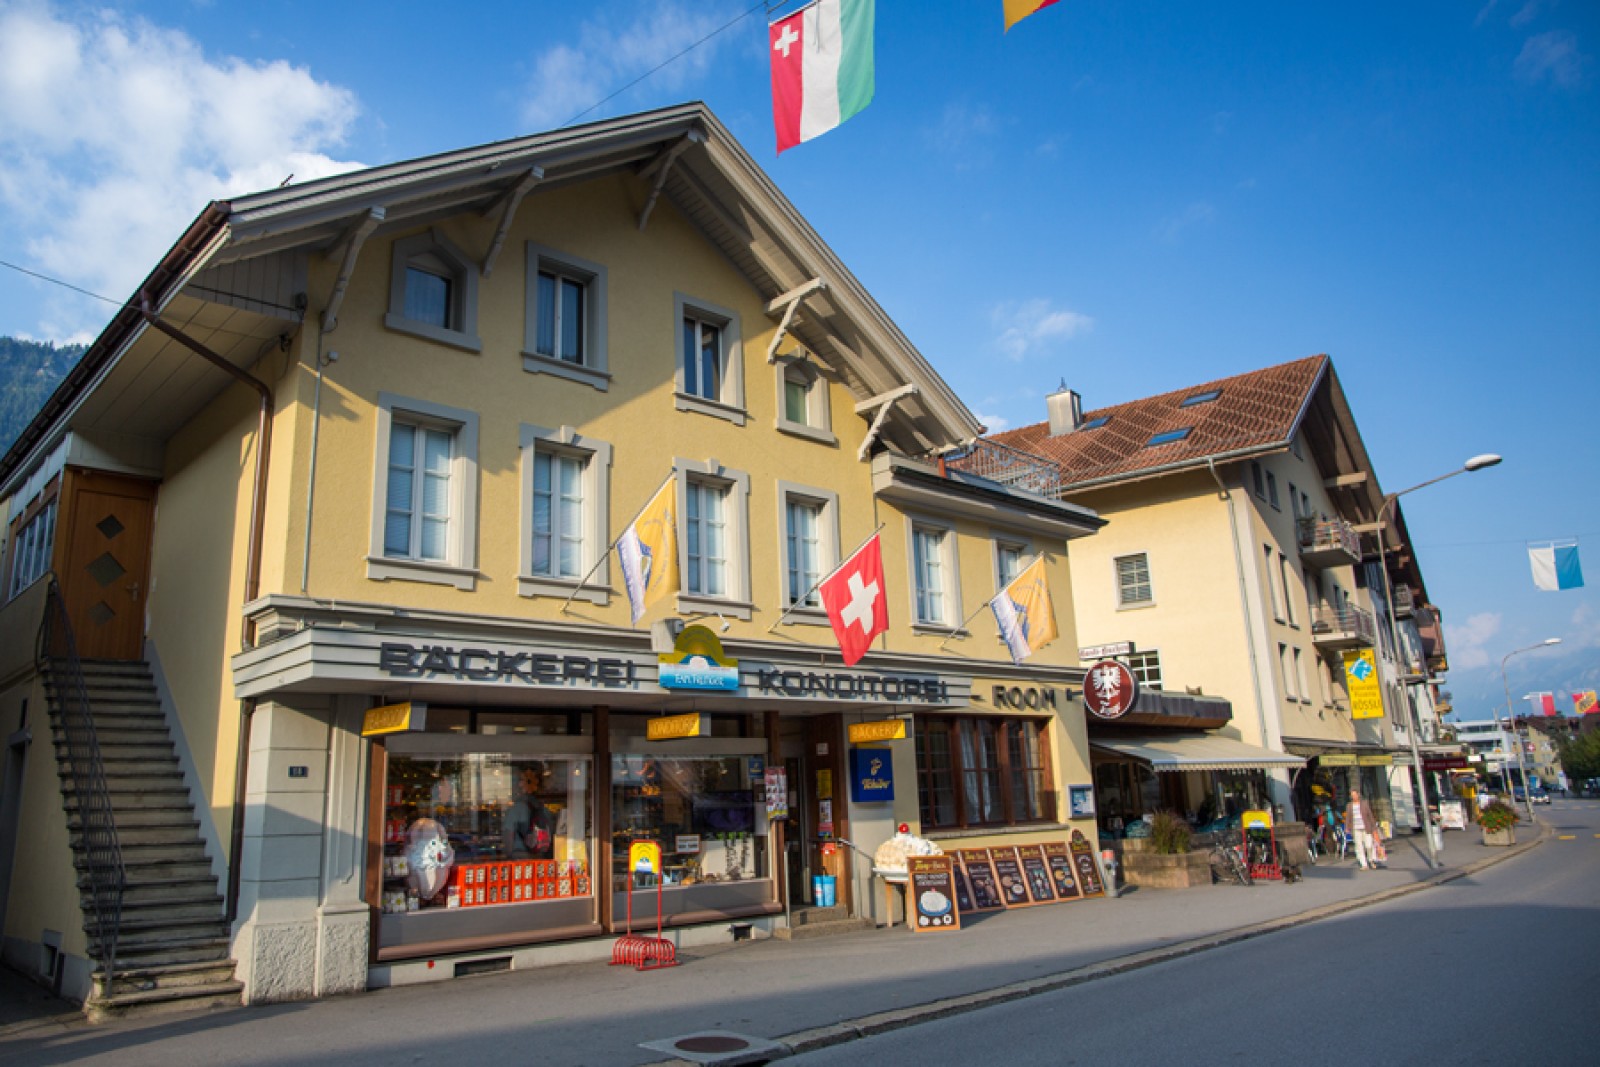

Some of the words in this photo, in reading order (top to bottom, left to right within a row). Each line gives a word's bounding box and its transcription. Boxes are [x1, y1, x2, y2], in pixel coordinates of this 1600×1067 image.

[380, 642, 633, 685] BÄCKEREI
[758, 669, 947, 701] KONDITOREI
[992, 685, 1056, 710] ROOM
